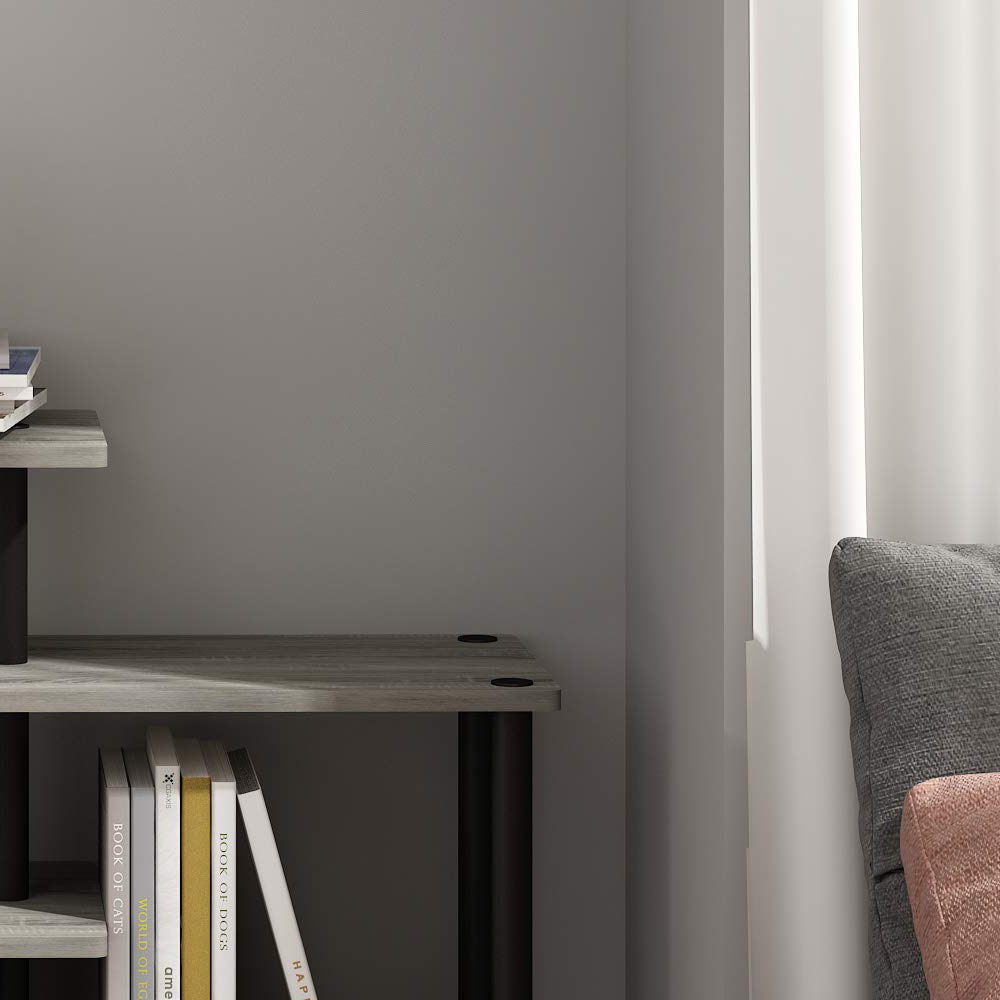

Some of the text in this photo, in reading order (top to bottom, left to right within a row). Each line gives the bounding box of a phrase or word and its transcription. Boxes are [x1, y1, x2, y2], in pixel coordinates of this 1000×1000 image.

[113, 823, 124, 934] BOOK OF CATS
[219, 833, 228, 951] BOOK OF DOGS
[137, 898, 149, 951] WORLD
[137, 956, 149, 976] OF
